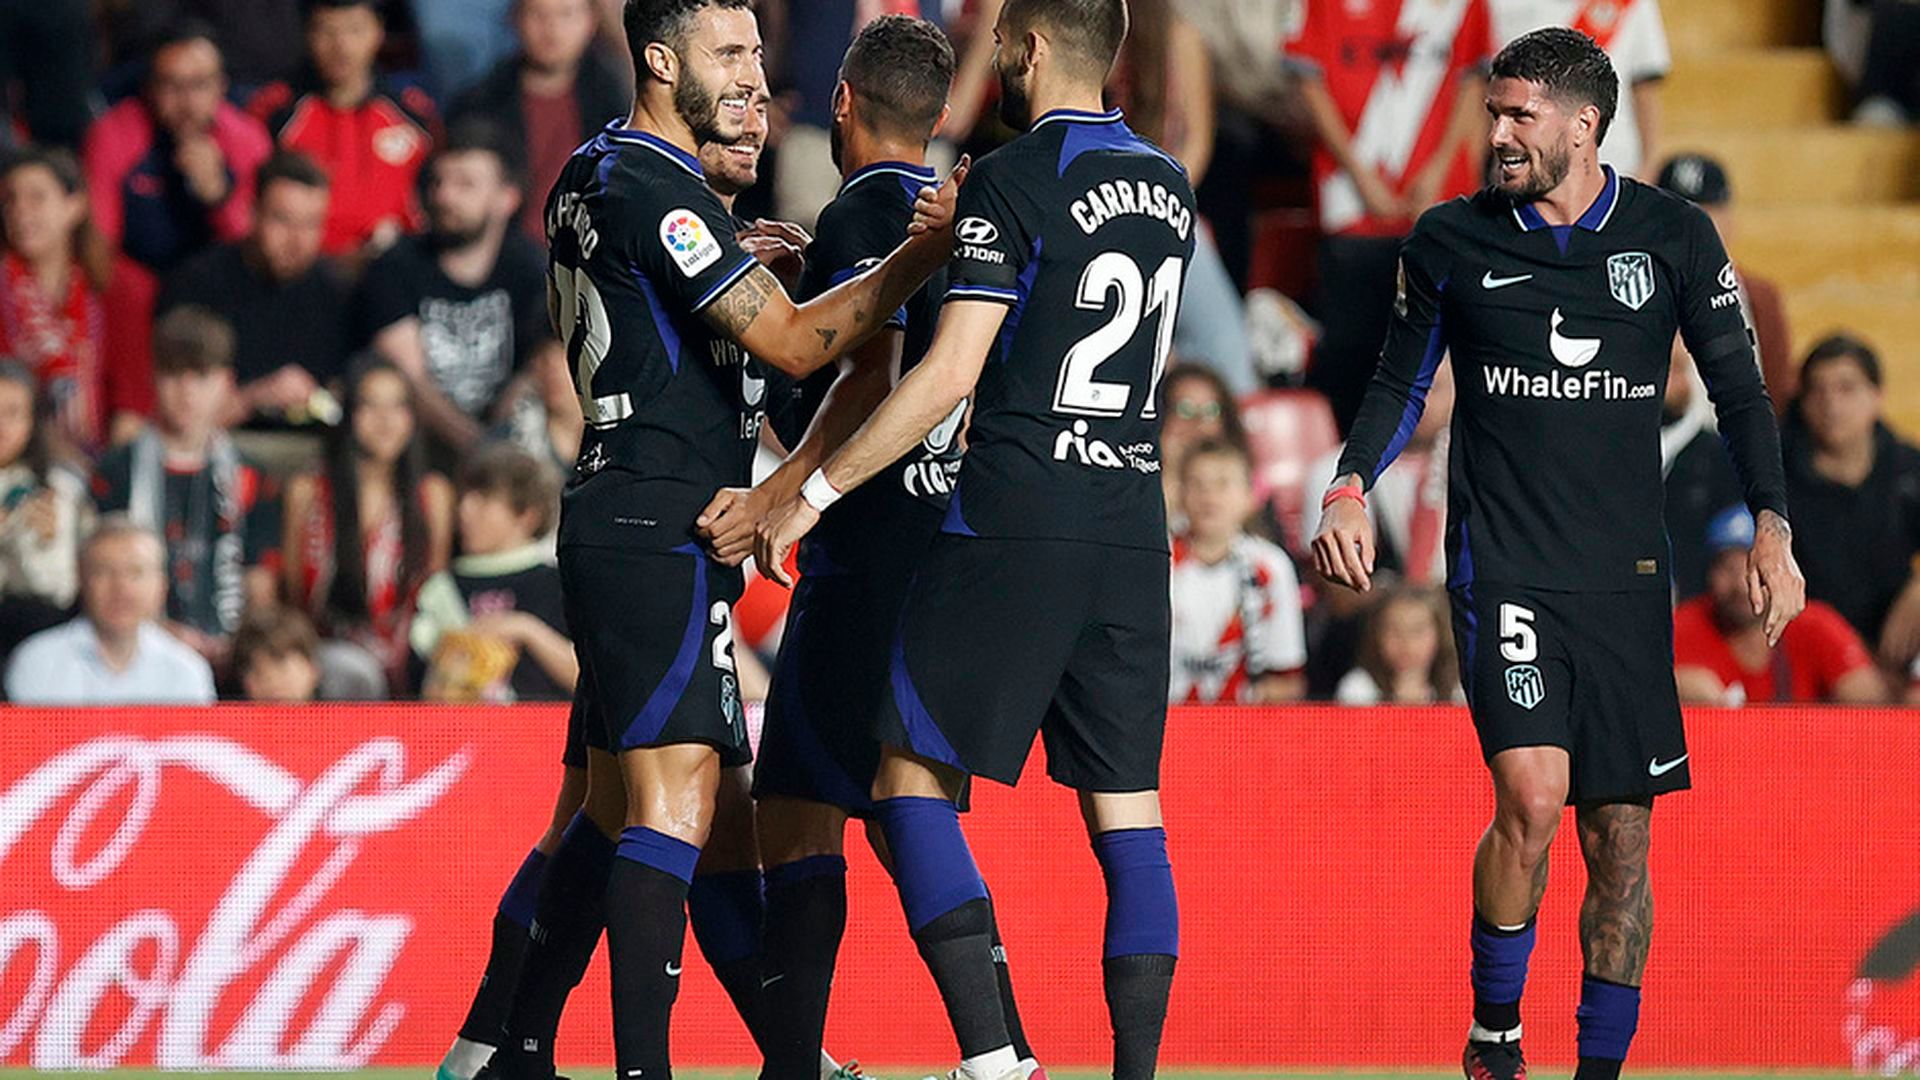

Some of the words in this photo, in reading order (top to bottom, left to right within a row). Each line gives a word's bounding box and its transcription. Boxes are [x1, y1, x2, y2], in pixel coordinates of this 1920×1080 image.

[1069, 179, 1191, 241] CARRASCO
[1051, 251, 1183, 419] 21
[1483, 365, 1656, 400] WhaleFin.com
[1053, 419, 1124, 468] ria
[903, 453, 950, 497] ria
[1500, 603, 1538, 662] 5
